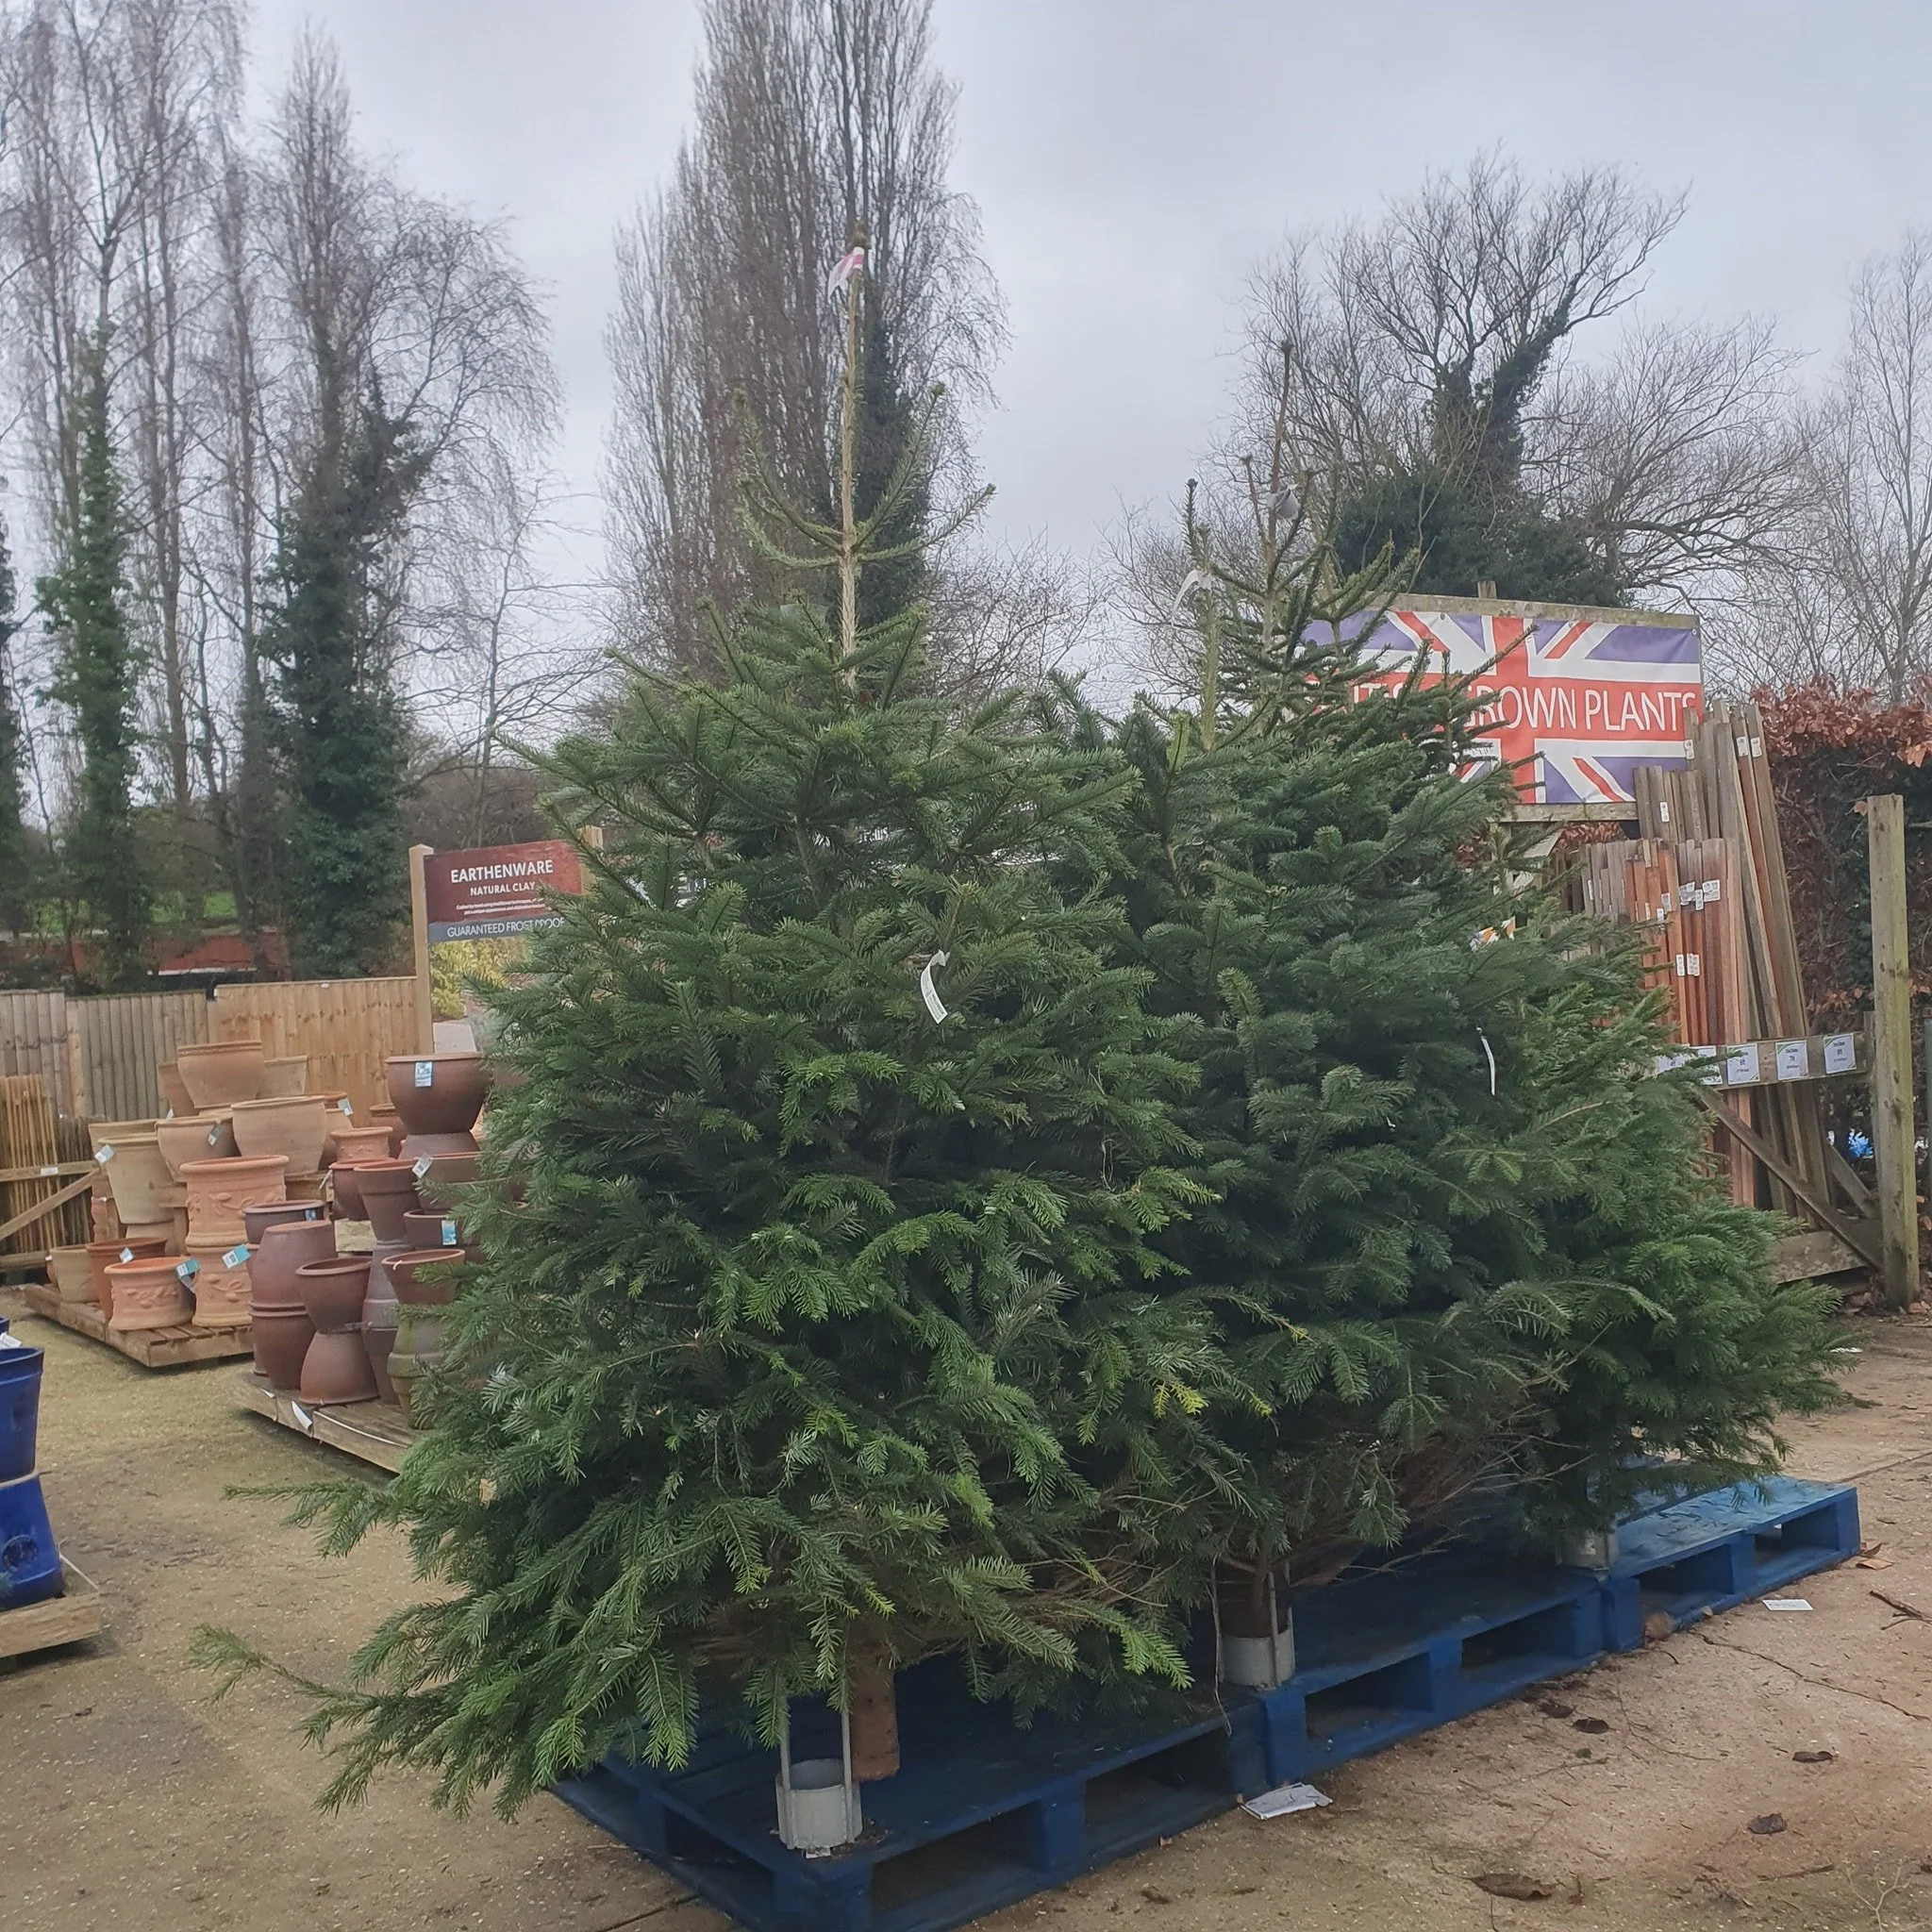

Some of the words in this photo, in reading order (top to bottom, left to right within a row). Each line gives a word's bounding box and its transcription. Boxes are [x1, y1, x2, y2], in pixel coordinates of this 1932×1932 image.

[451, 859, 554, 883] EARTHENWARE
[470, 885, 511, 896] NATURAL
[512, 881, 536, 892] CLAY
[446, 923, 505, 938] GUARANTEED
[506, 920, 533, 932] FROST
